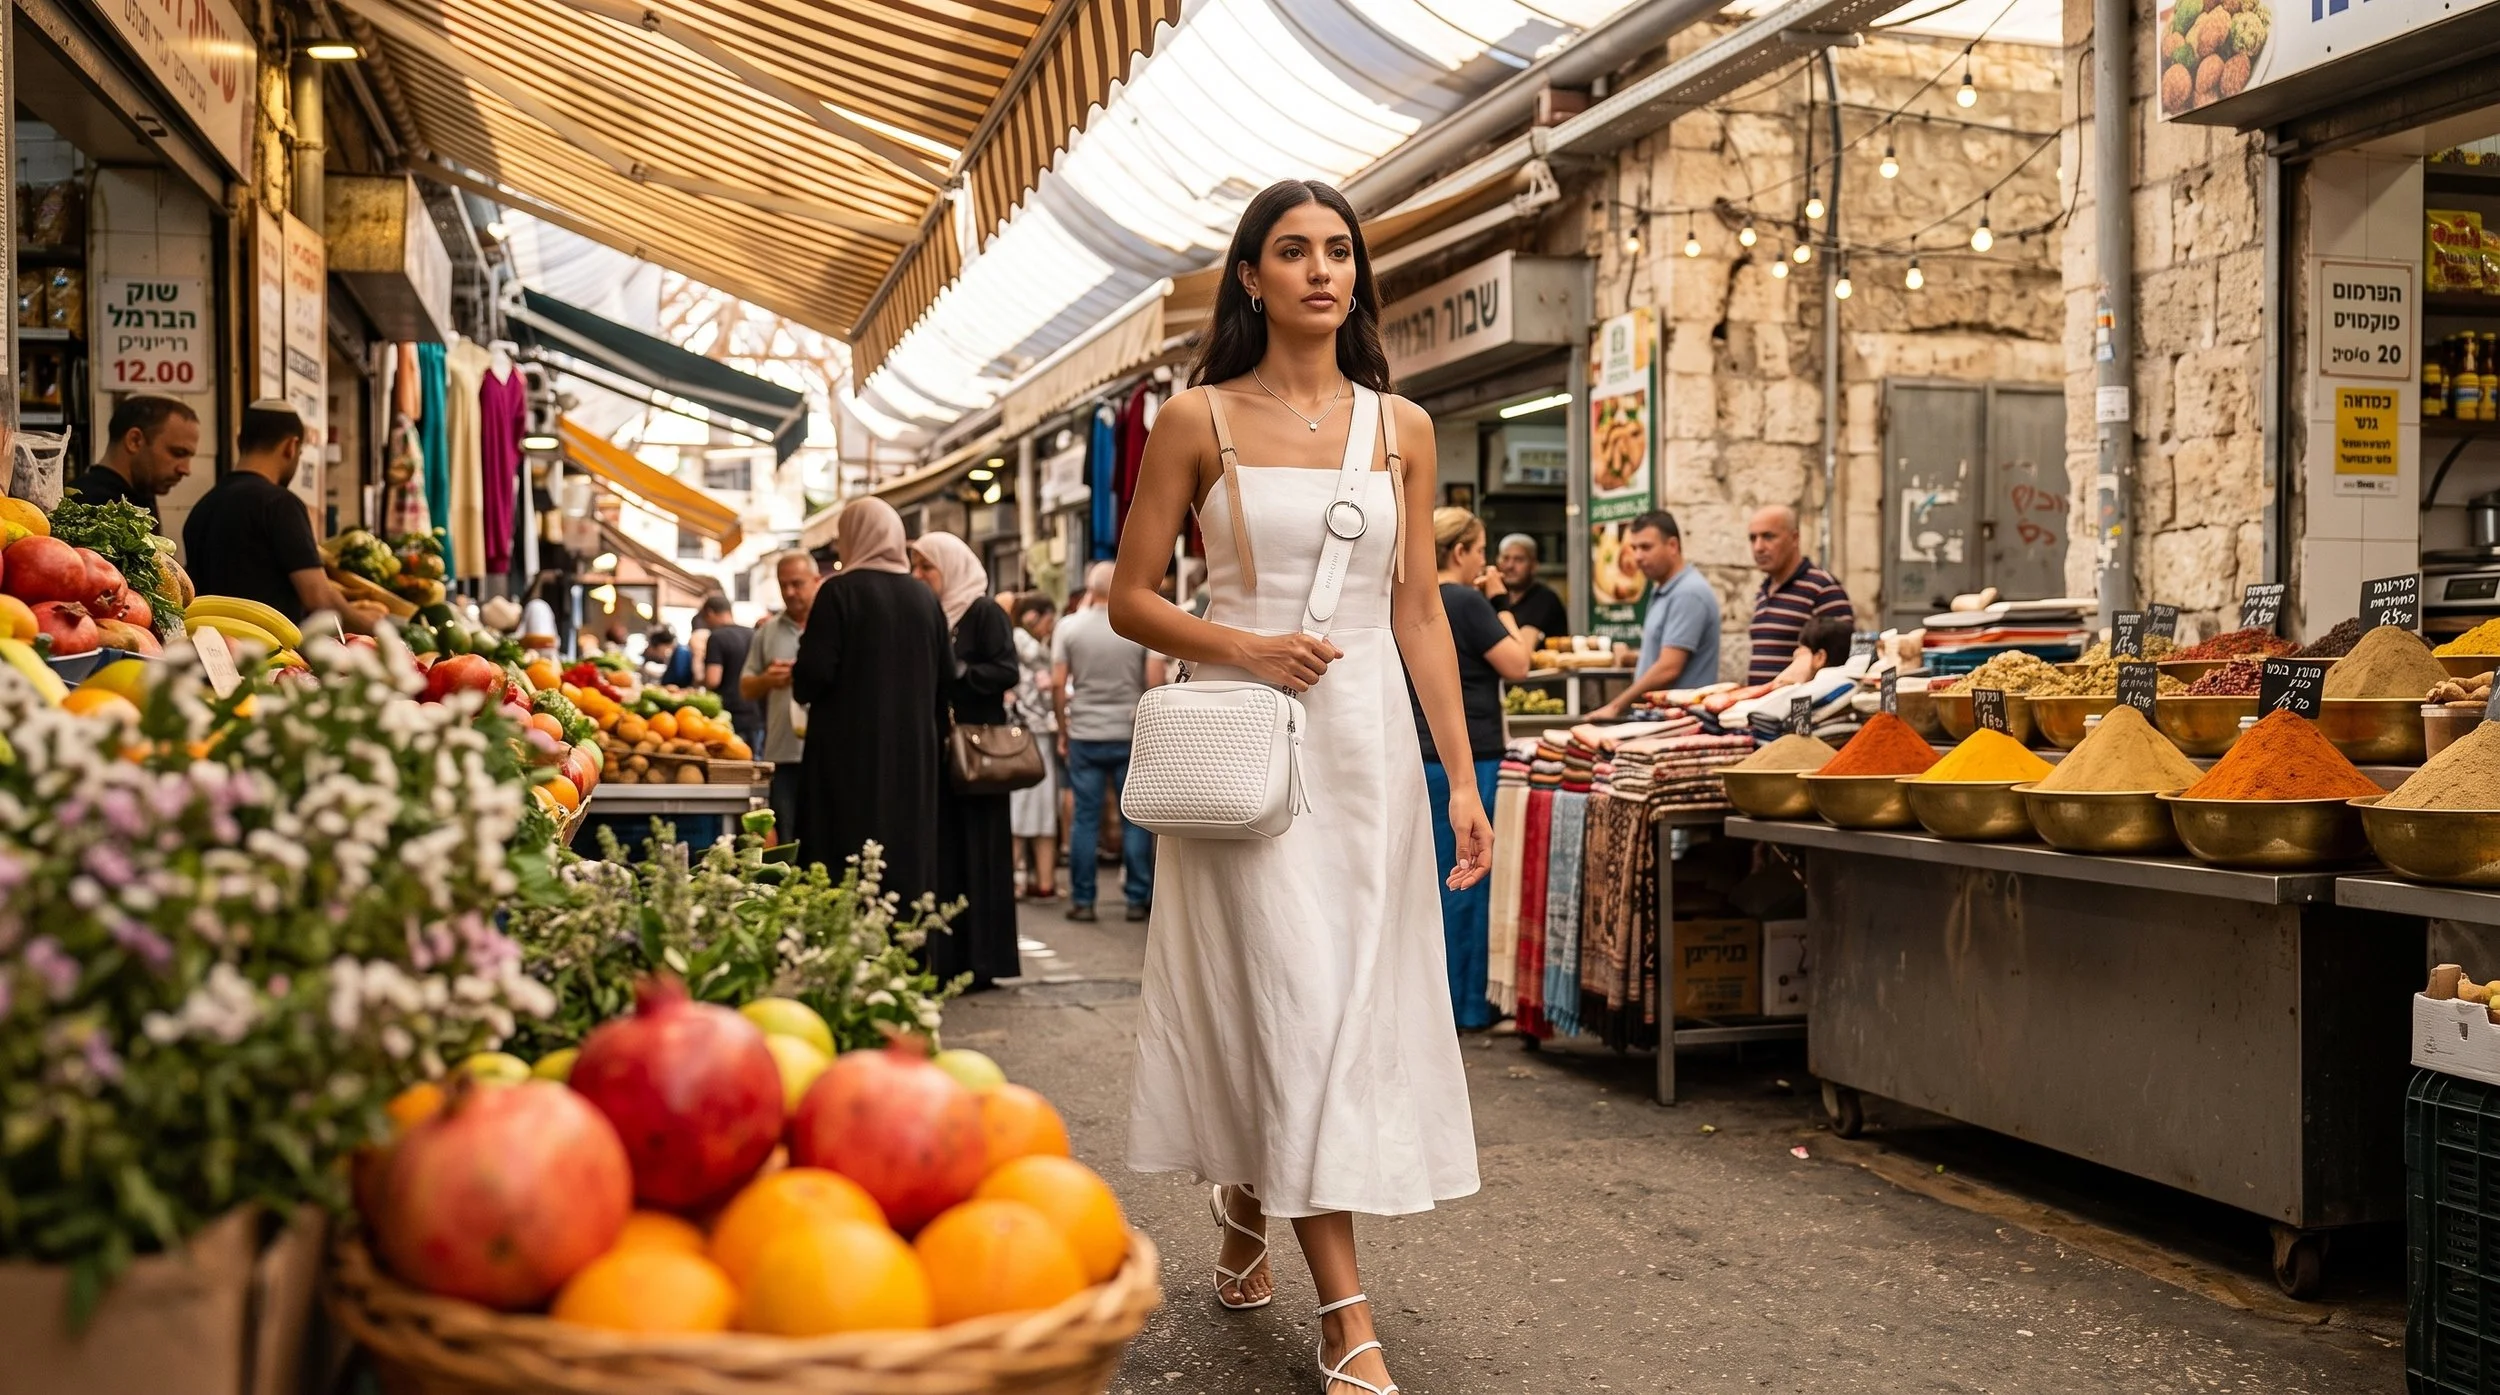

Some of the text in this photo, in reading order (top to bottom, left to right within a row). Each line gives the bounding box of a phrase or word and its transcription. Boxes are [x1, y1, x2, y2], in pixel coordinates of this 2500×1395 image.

[127, 283, 178, 306] שוק
[107, 302, 197, 329] הברמל
[2377, 344, 2402, 365] 20
[114, 359, 194, 384] 12.00
